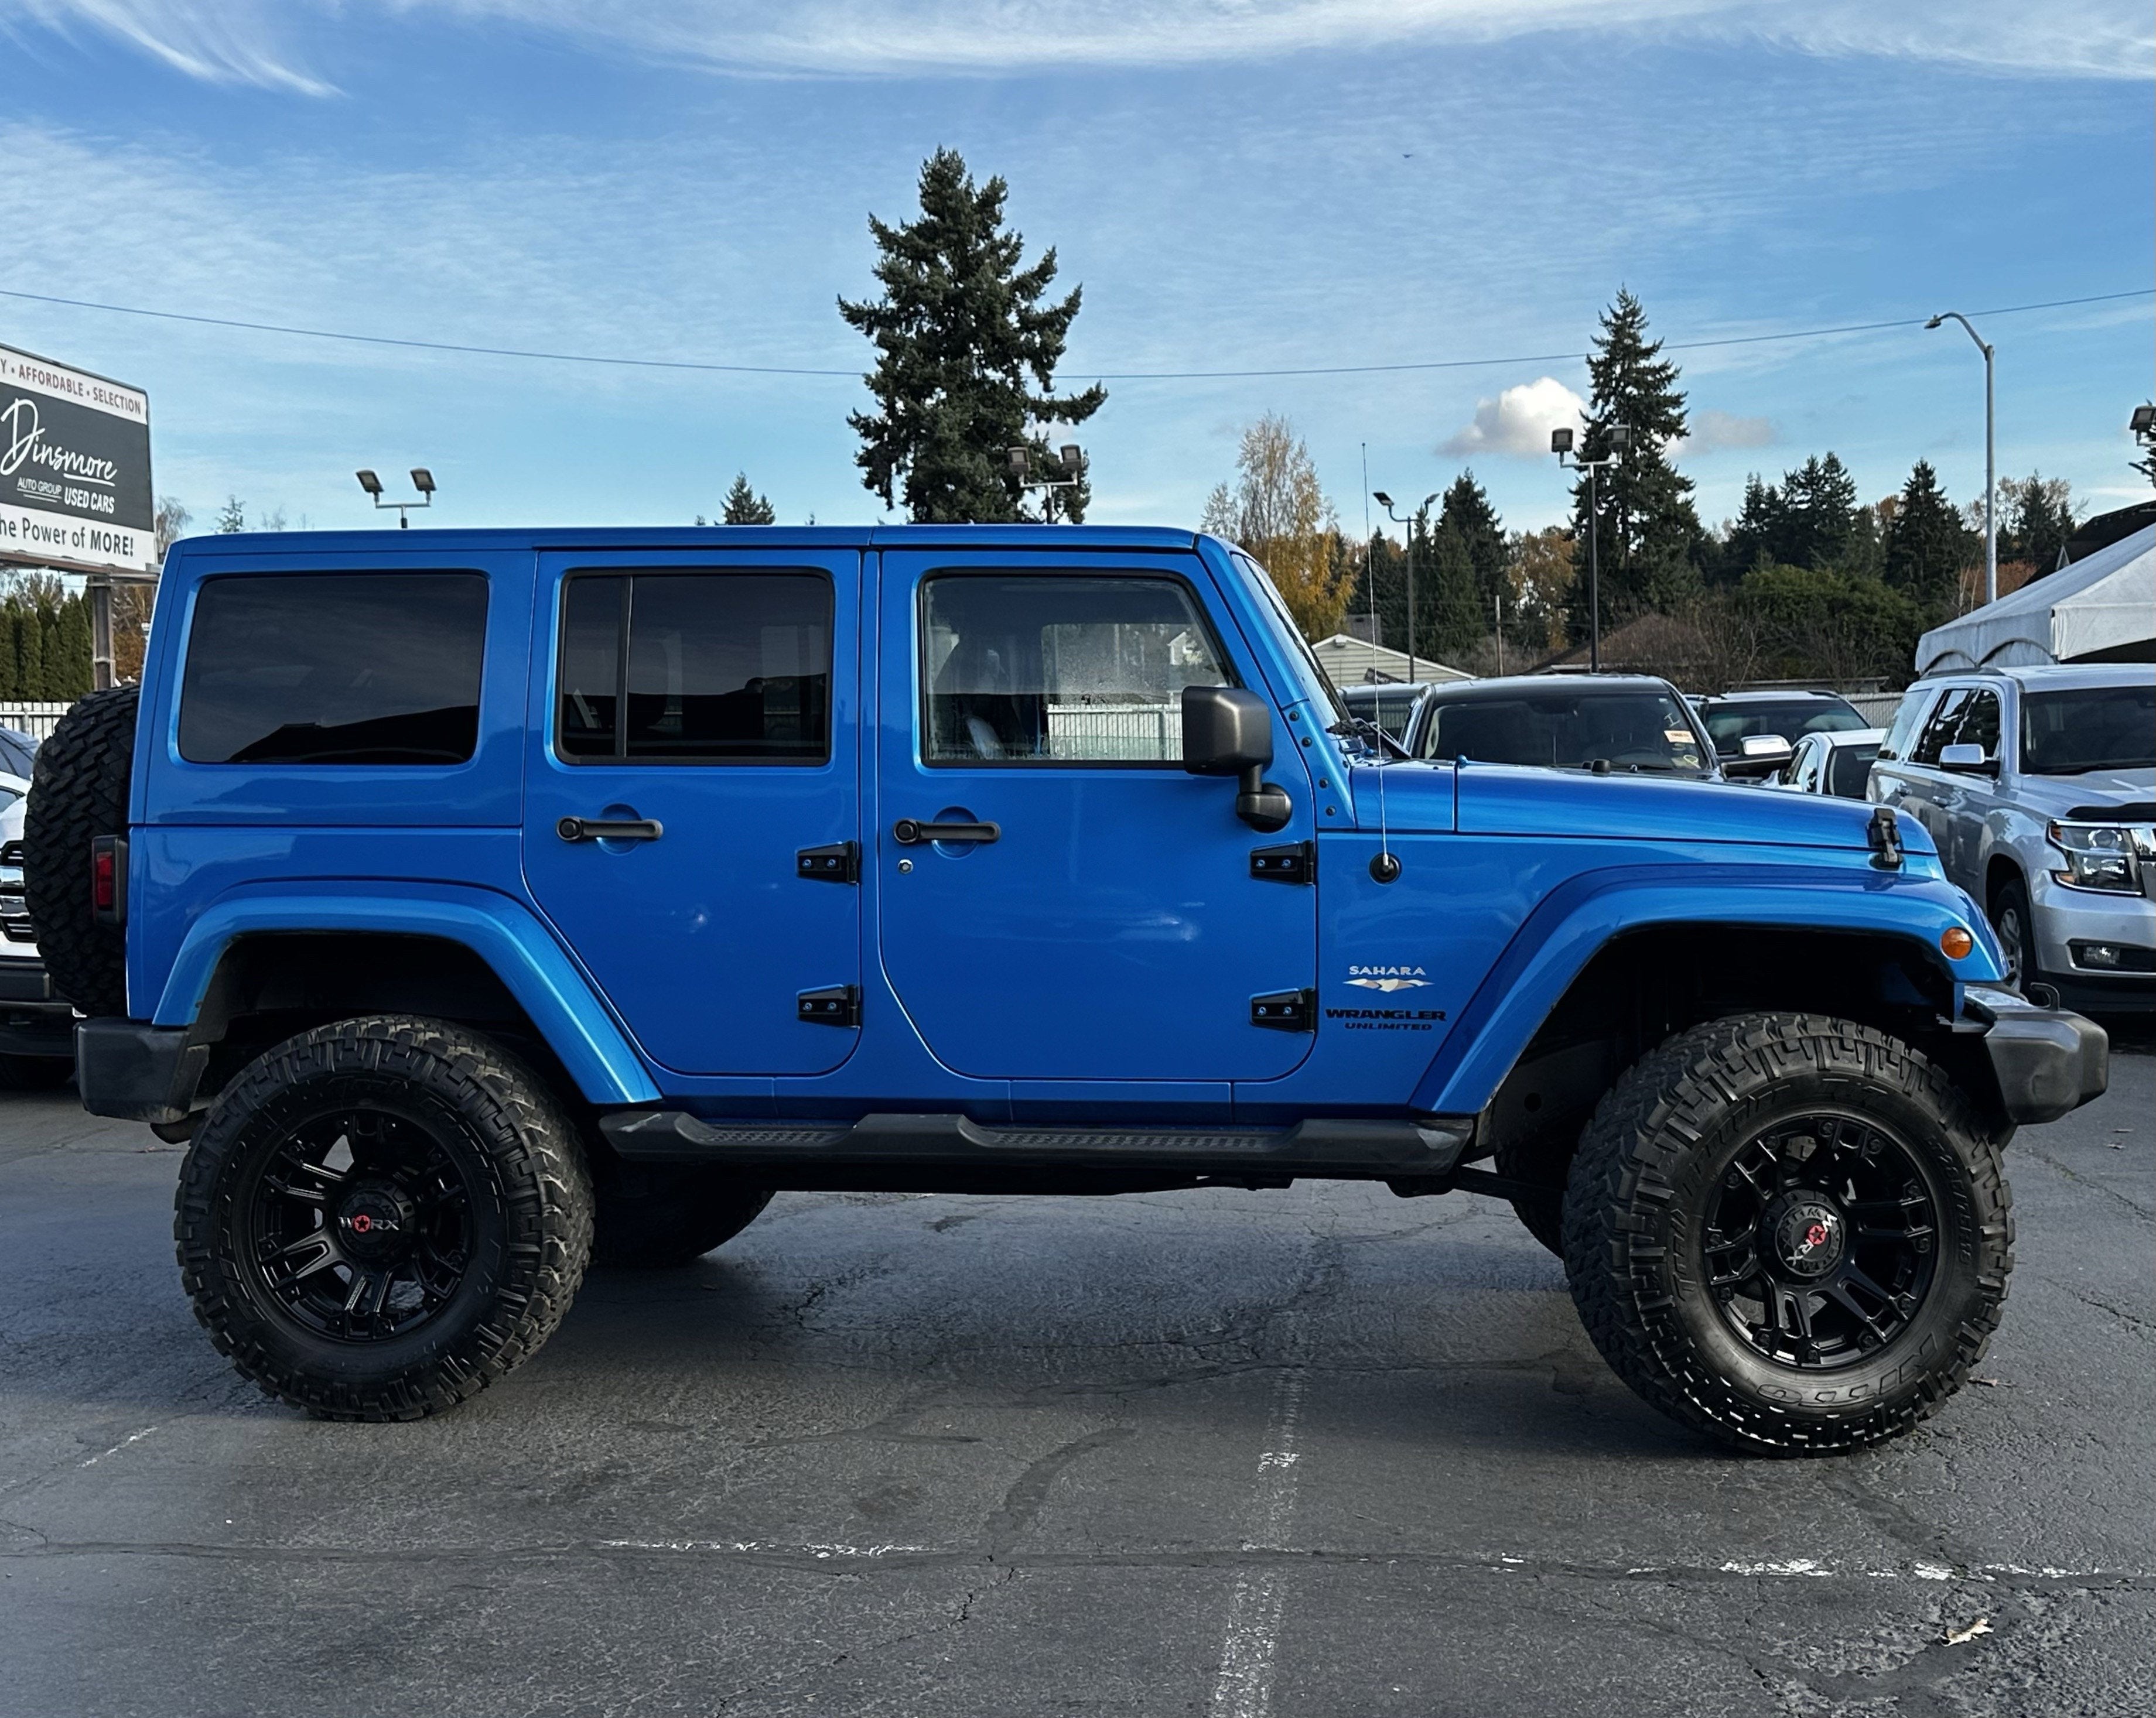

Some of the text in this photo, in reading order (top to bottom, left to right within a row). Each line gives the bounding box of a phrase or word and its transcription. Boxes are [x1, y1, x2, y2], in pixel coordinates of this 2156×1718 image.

[19, 364, 84, 397] AFFORDABLE
[93, 386, 141, 415] SELECTION
[0, 397, 117, 480] Dinsmore
[17, 477, 115, 514] AUTO GROUP USED CARS
[22, 517, 67, 545] Power
[71, 526, 86, 548] of
[90, 531, 134, 557] MORE!
[1349, 966, 1426, 976] SAHARA
[1325, 1008, 1447, 1022] WRANGLER
[1345, 1022, 1433, 1031] UNLIMITED
